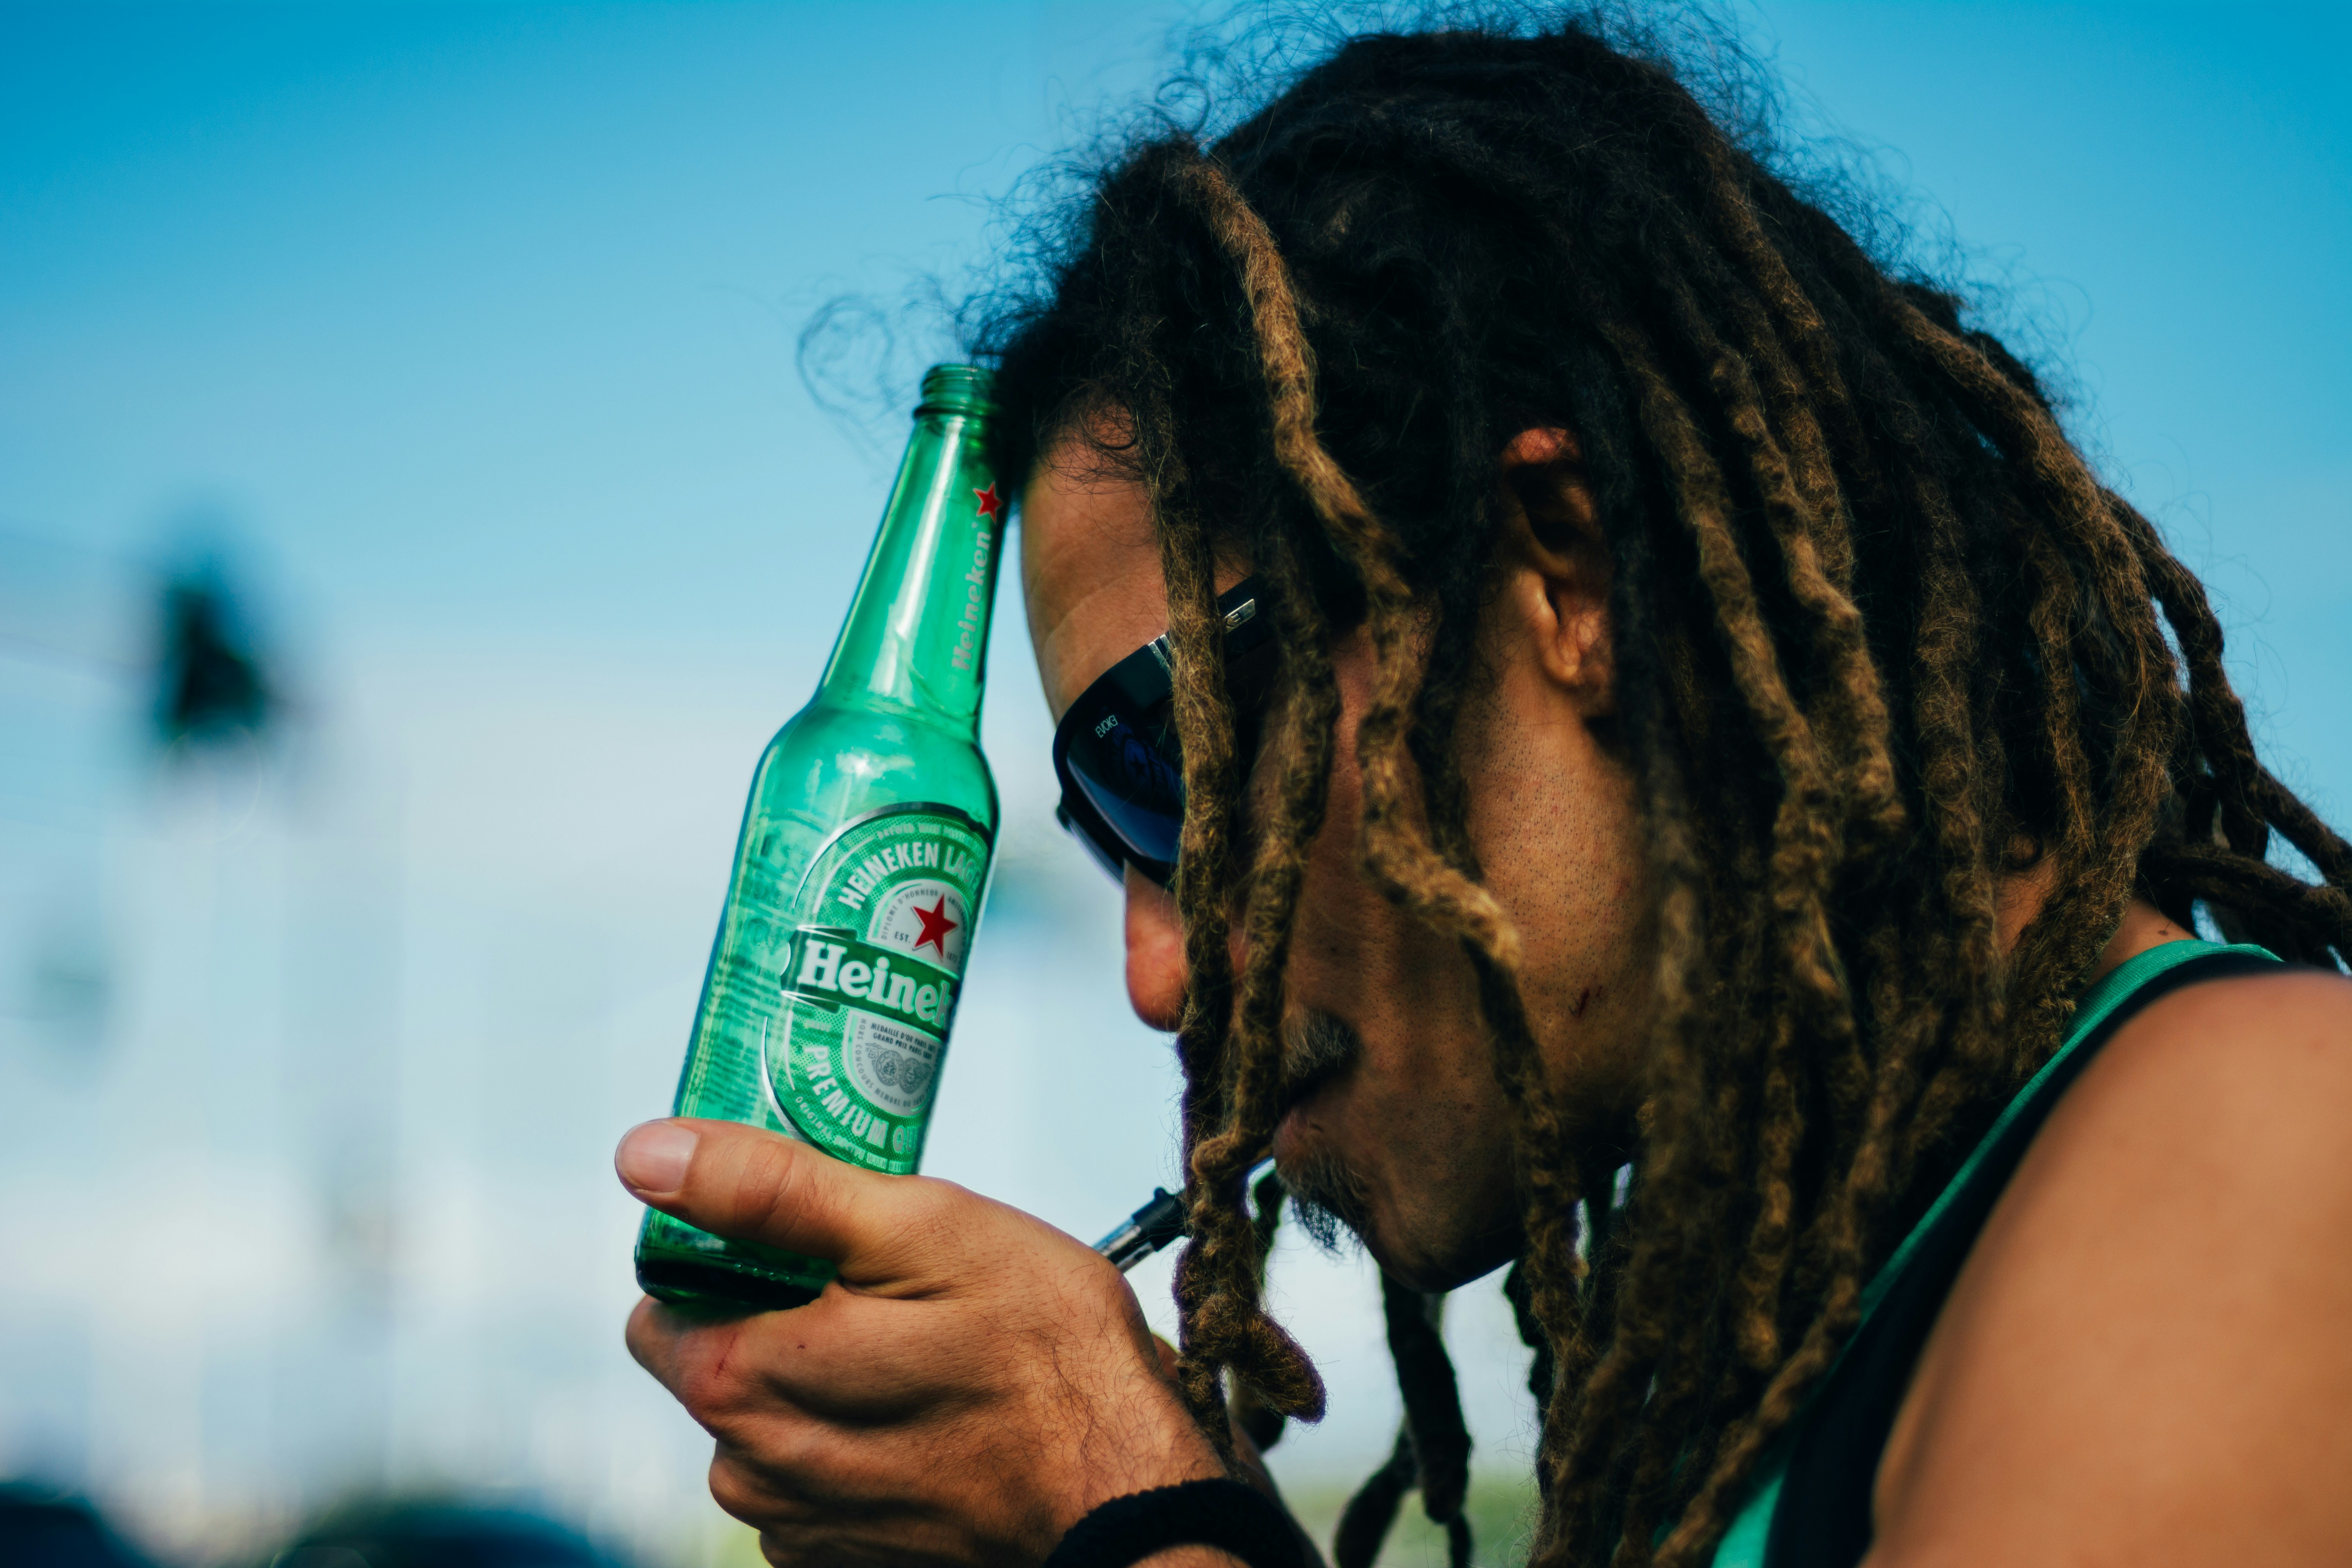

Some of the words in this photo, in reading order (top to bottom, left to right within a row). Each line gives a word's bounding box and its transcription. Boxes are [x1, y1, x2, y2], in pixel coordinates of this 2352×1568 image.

[837, 842, 939, 910] HEINEKEN
[881, 905, 898, 940] DIPLOME
[898, 889, 938, 905] D'HONNEUR
[895, 931, 911, 944] EST.
[857, 1018, 867, 1040] HORS
[871, 1022, 899, 1038] MEDAILLE
[901, 1033, 913, 1043] D'OR
[873, 1032, 893, 1044] GRAND
[895, 1039, 907, 1050] PRIX
[909, 1044, 922, 1056] PARIS
[855, 1044, 874, 1089] CONCOURS
[804, 1046, 889, 1149] PREMIUM
[875, 1088, 901, 1106] MEMBRE
[866, 1152, 888, 1170] WITH
